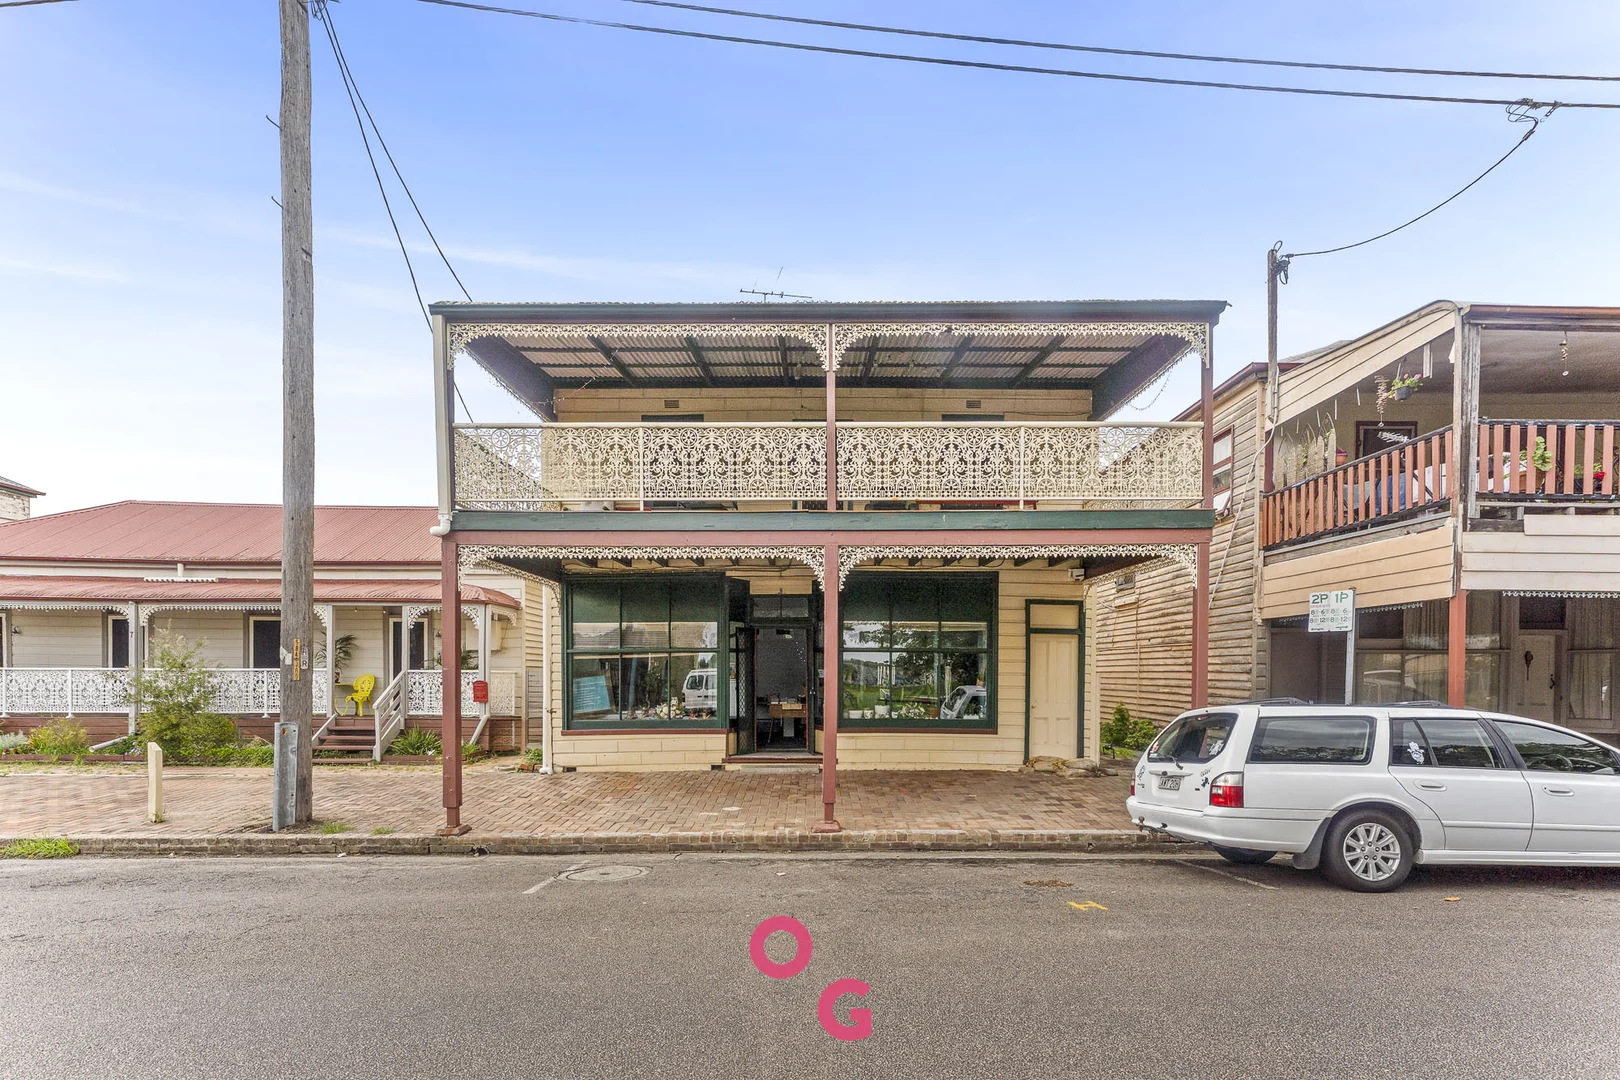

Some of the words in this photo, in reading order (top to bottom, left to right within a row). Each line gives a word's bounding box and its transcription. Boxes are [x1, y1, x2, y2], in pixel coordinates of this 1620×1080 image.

[1311, 593, 1329, 604] 2P
[1335, 592, 1349, 603] 1P
[302, 659, 308, 667] R
